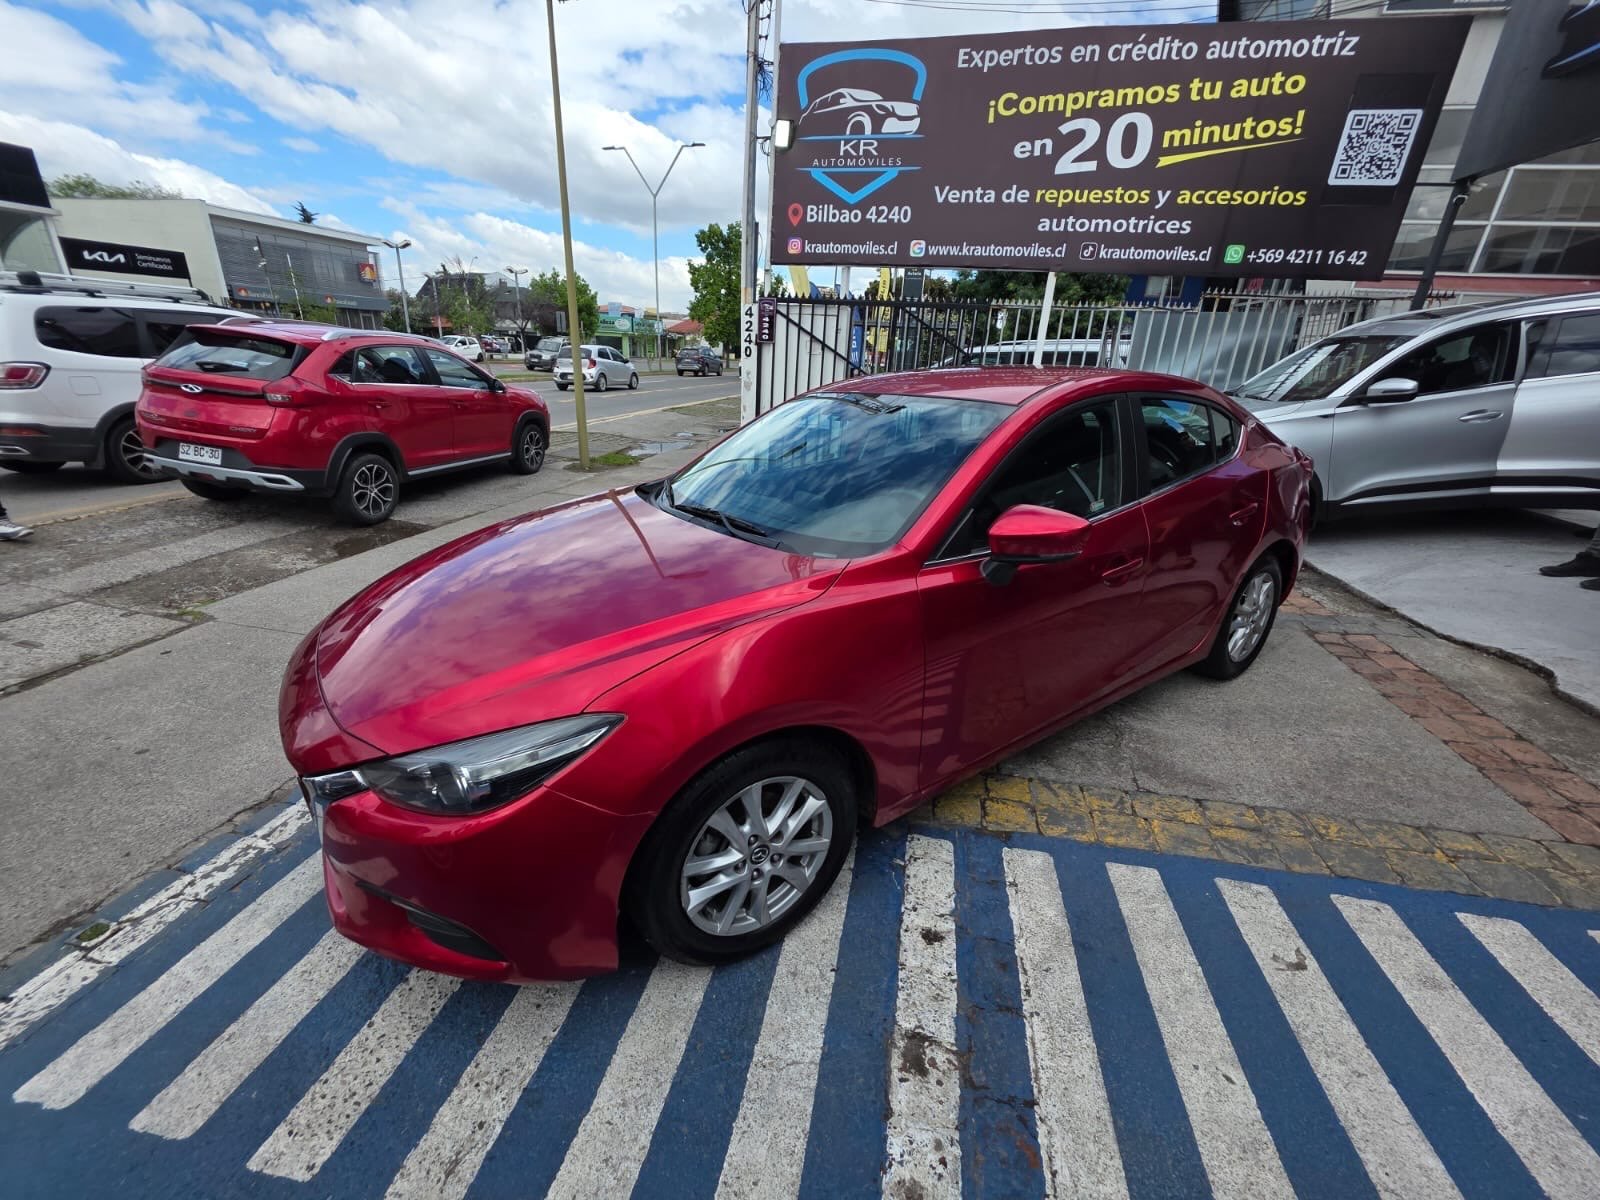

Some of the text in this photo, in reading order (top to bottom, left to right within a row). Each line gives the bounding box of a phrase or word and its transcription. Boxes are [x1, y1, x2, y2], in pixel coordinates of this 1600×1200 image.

[958, 31, 1360, 72] Expertos en crédito automotriz
[988, 72, 1306, 123] ¡Compramos tu auto
[840, 140, 878, 155] KR
[1014, 110, 1305, 175] en 20 minutos!
[812, 157, 902, 167] AUTOMÓVILES
[935, 185, 1306, 208] Venta de repuestos y accesorios
[807, 204, 911, 223] Bilbao 4240
[1038, 215, 1191, 234] automotrices
[805, 240, 897, 254] krautomoviles.cl
[929, 242, 1066, 257] www.krautomoviles.cl
[1099, 244, 1211, 261] krautomoviles.cl
[1248, 249, 1366, 264] +569 4211 16 42
[743, 305, 754, 358] 4240
